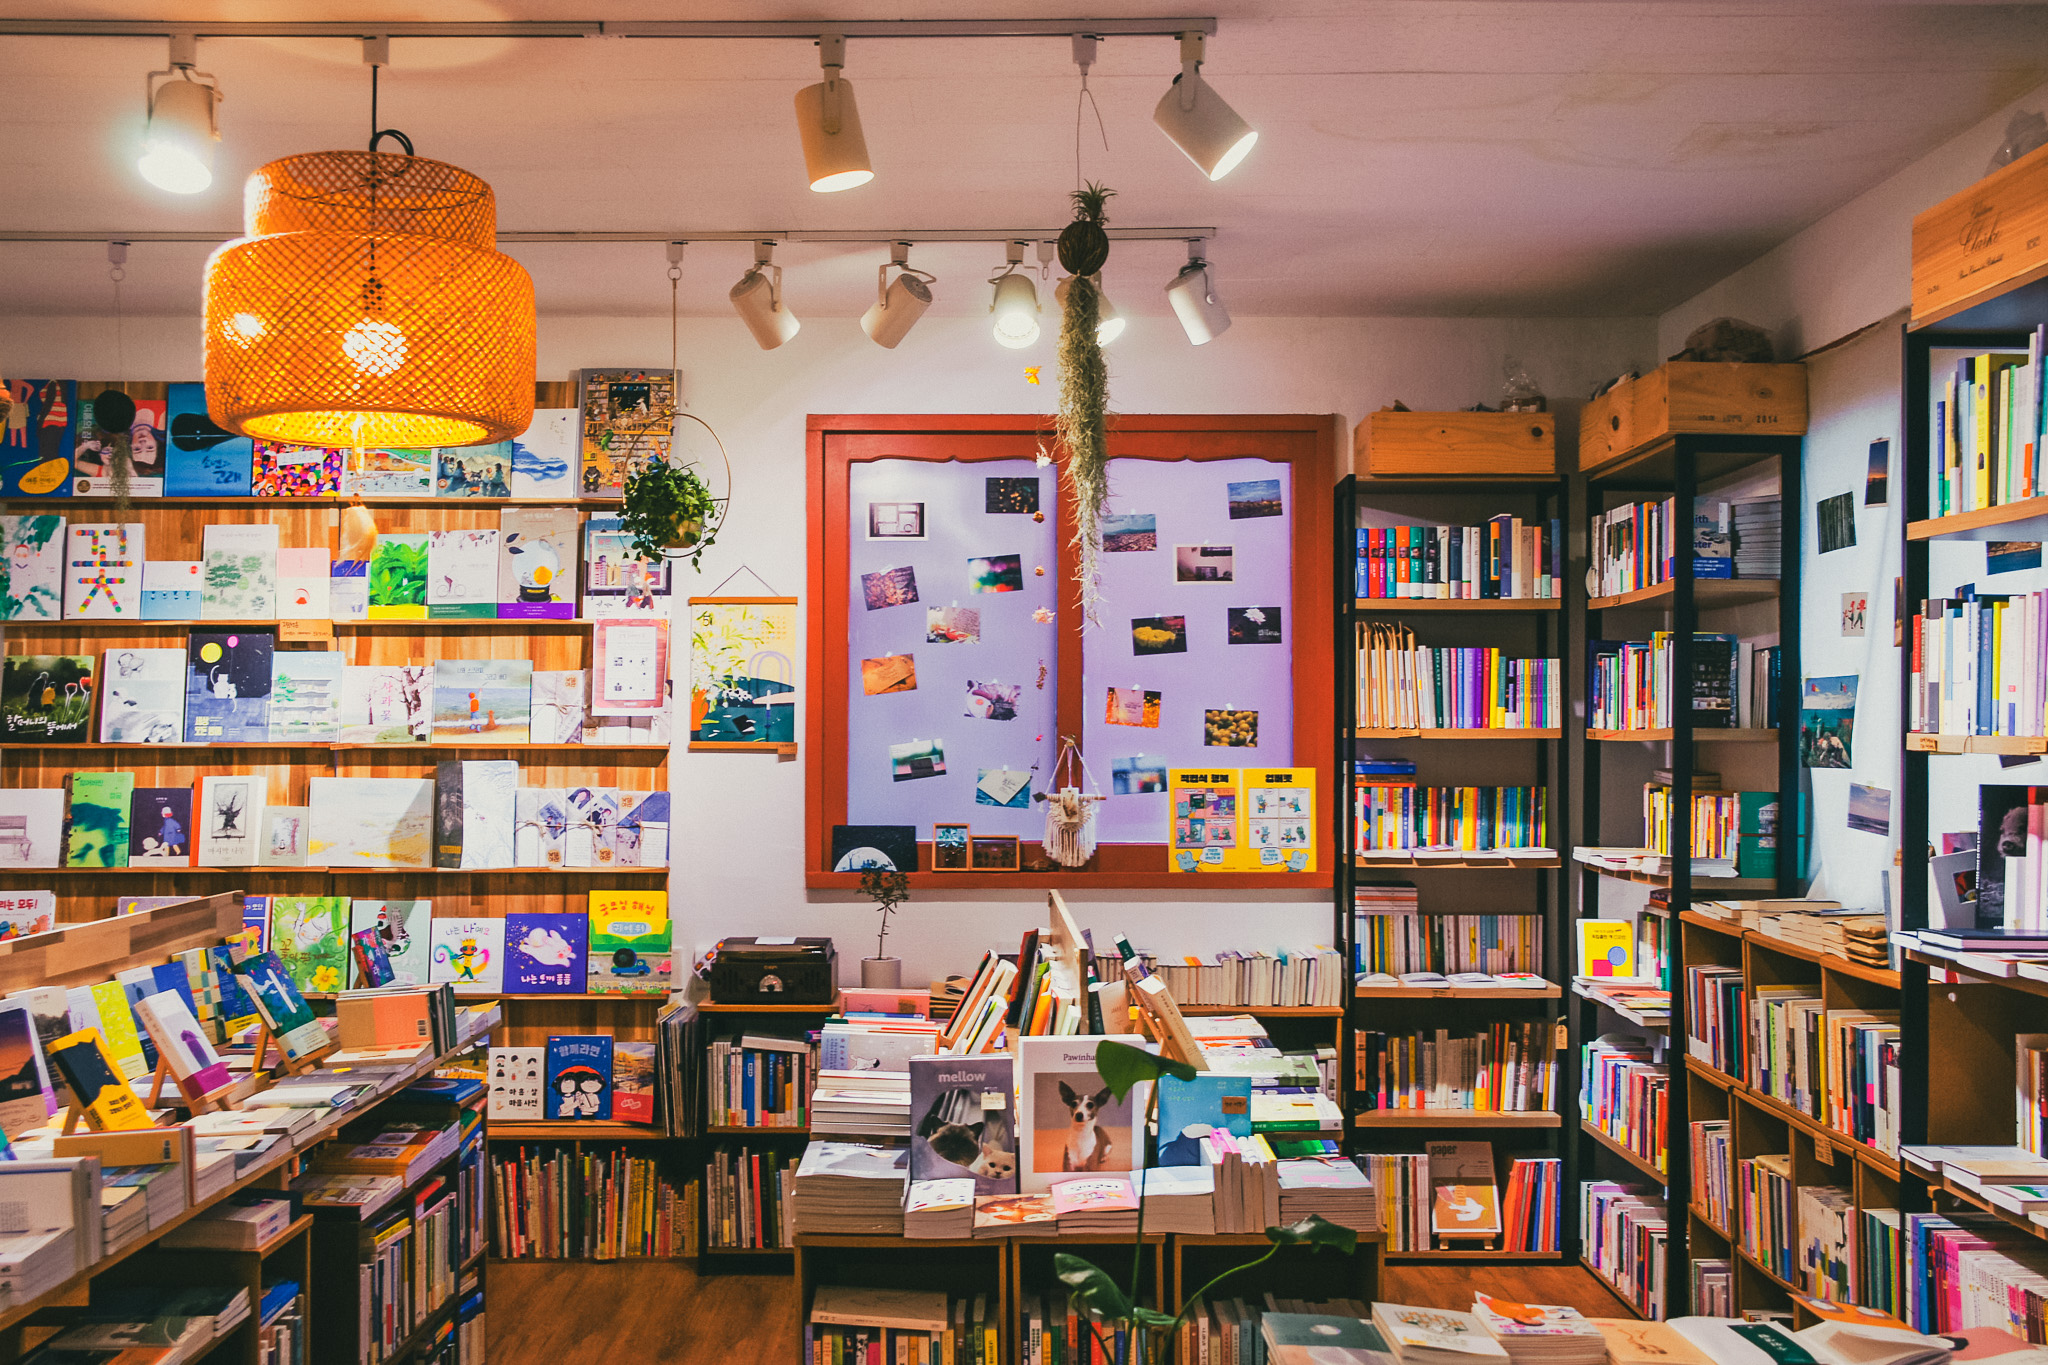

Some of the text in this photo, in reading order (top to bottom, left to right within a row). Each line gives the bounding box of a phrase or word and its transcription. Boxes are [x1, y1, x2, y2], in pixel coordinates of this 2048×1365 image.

[1756, 415, 1778, 424] 2014
[212, 470, 242, 485] 고래
[1695, 514, 1709, 524] ith
[72, 529, 133, 613] 꽃
[380, 681, 394, 722] 사과꽃
[6, 714, 48, 732] 할머니의
[47, 720, 78, 736] 뜰에서
[17, 898, 38, 910] 모두!
[445, 925, 460, 936] 나는
[520, 975, 538, 985] 나는
[539, 974, 555, 985] 토끼
[558, 1043, 601, 1058] 함께라면
[1063, 1053, 1096, 1062] Pawinha
[938, 1071, 987, 1083] mellow
[1430, 1144, 1458, 1157] paper
